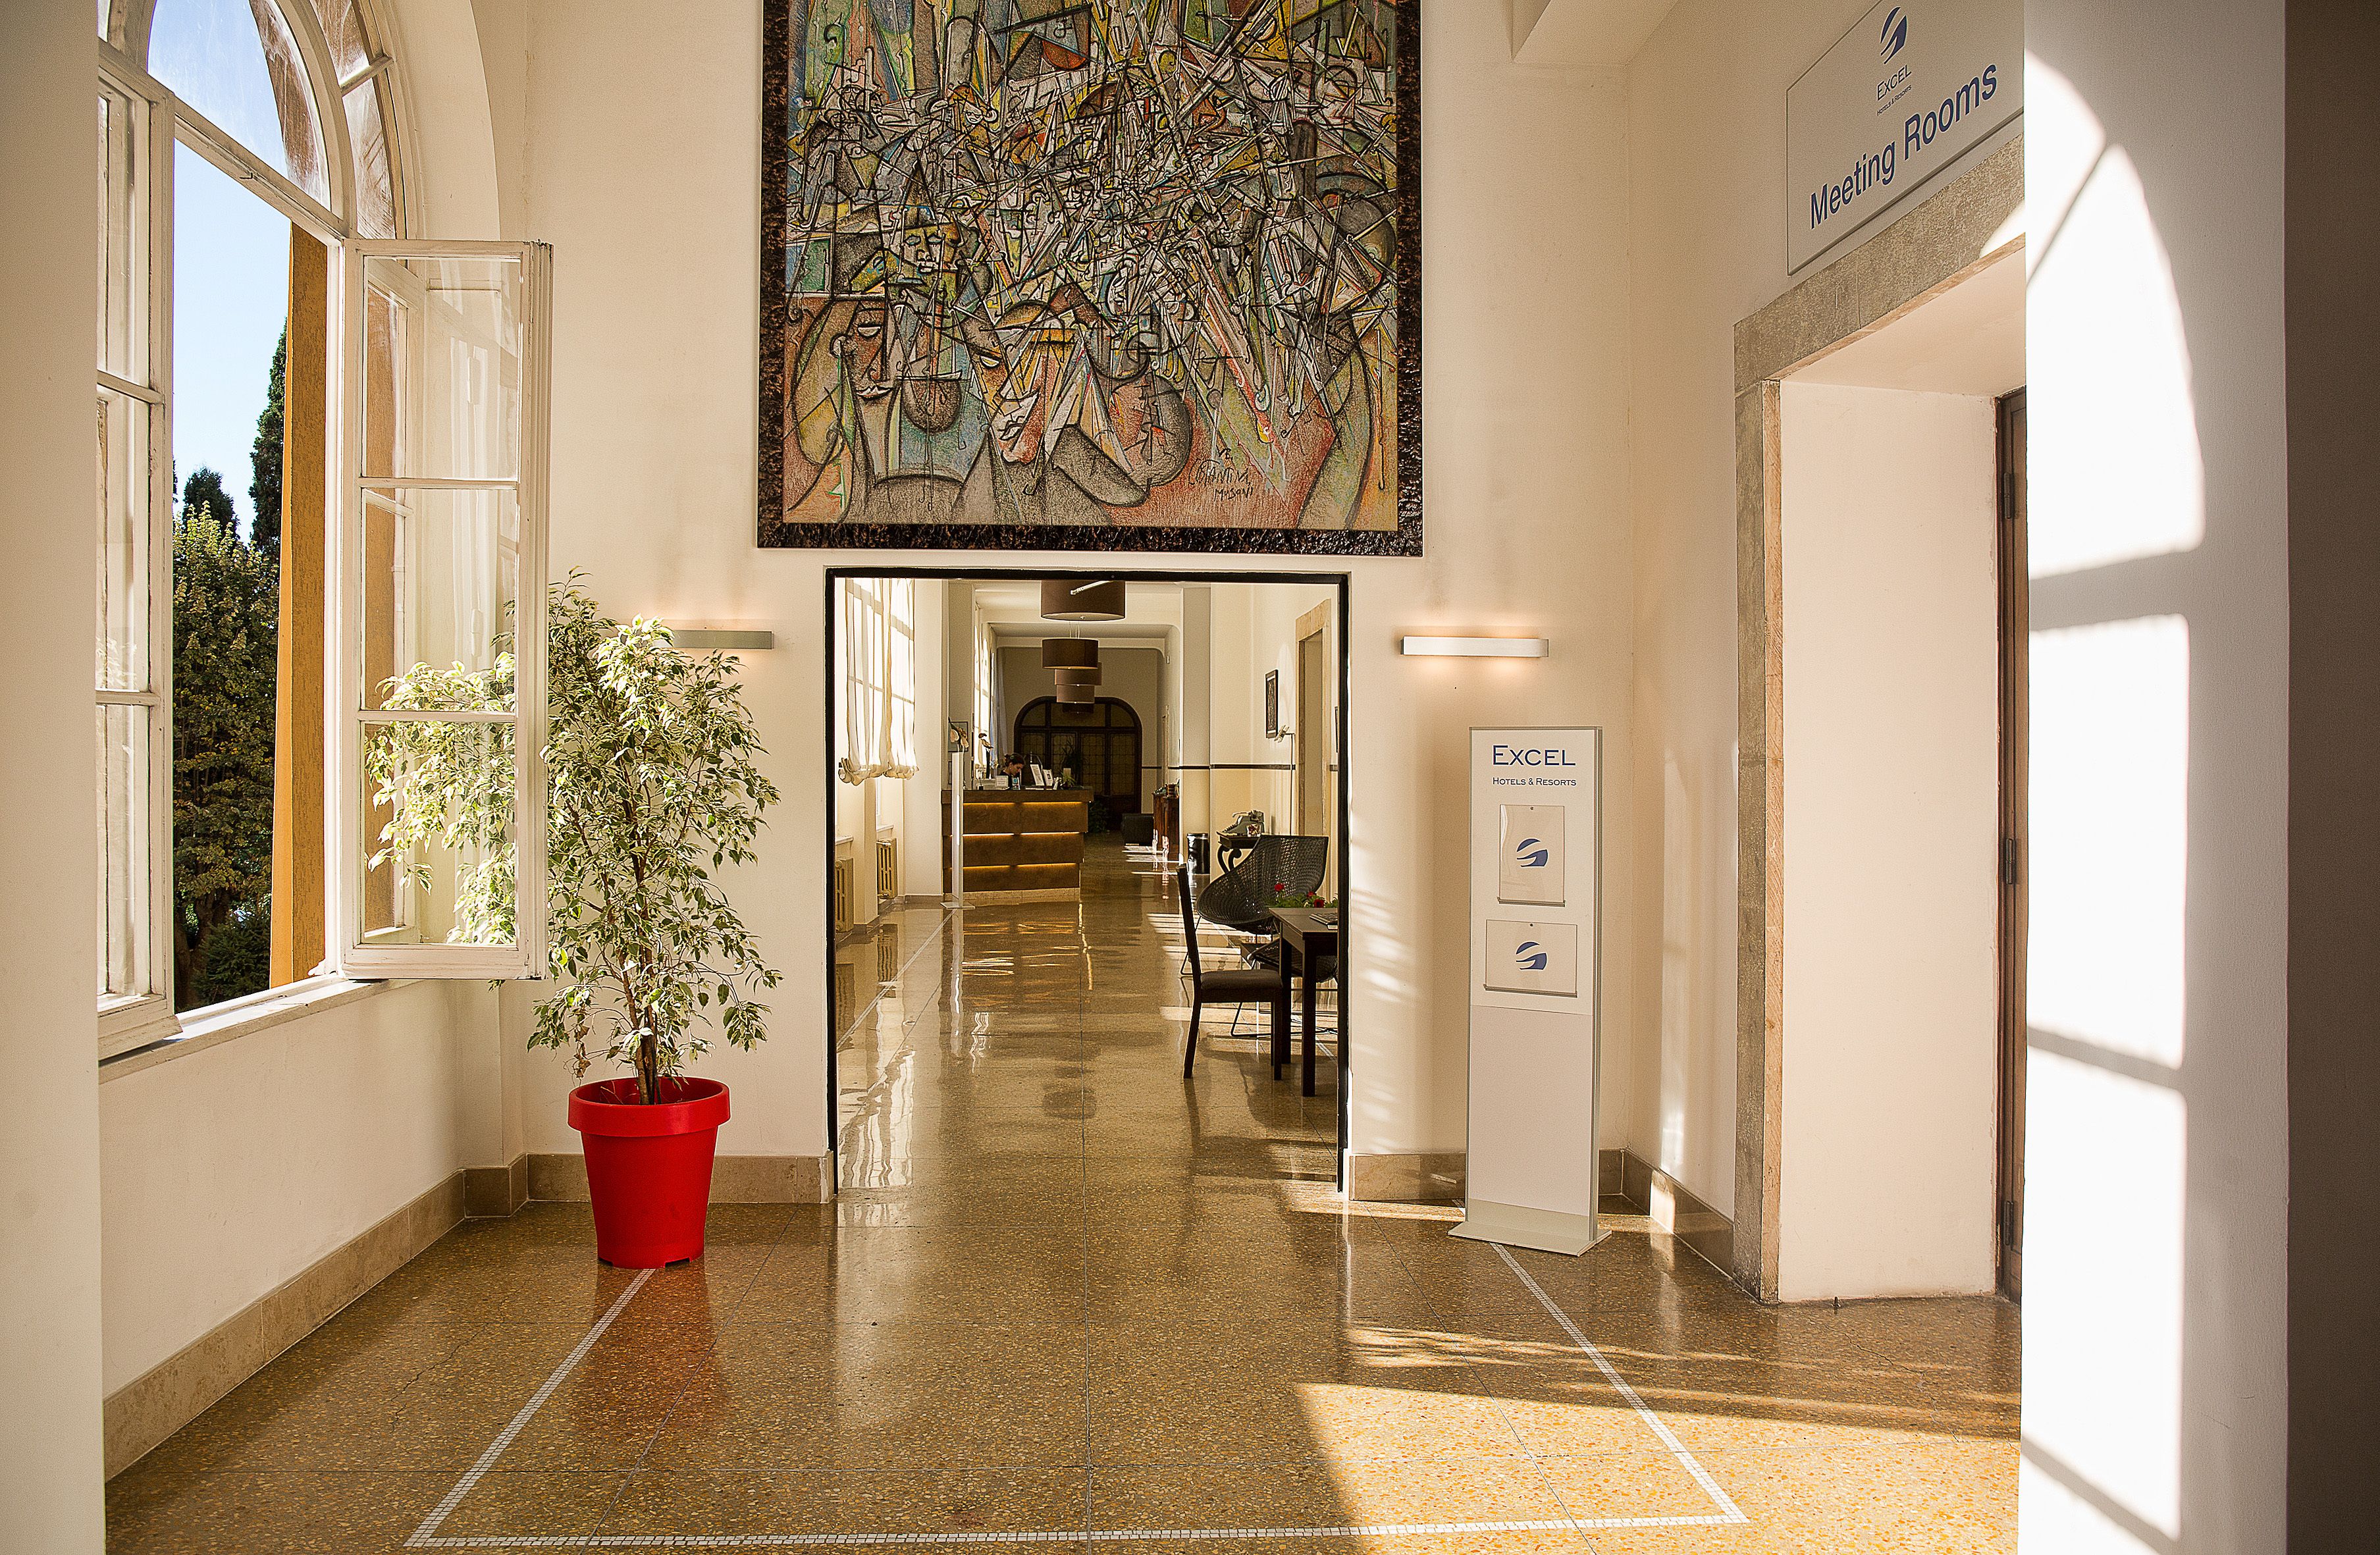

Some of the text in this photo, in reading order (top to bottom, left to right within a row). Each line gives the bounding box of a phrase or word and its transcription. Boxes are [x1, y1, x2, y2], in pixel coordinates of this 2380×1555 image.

[1877, 65, 1912, 101] EXCEL
[1810, 64, 1997, 230] Meeting Rooms
[1493, 745, 1576, 766] EXCEL
[1493, 777, 1526, 785] HOTELS
[1536, 778, 1577, 786] RESORTS
